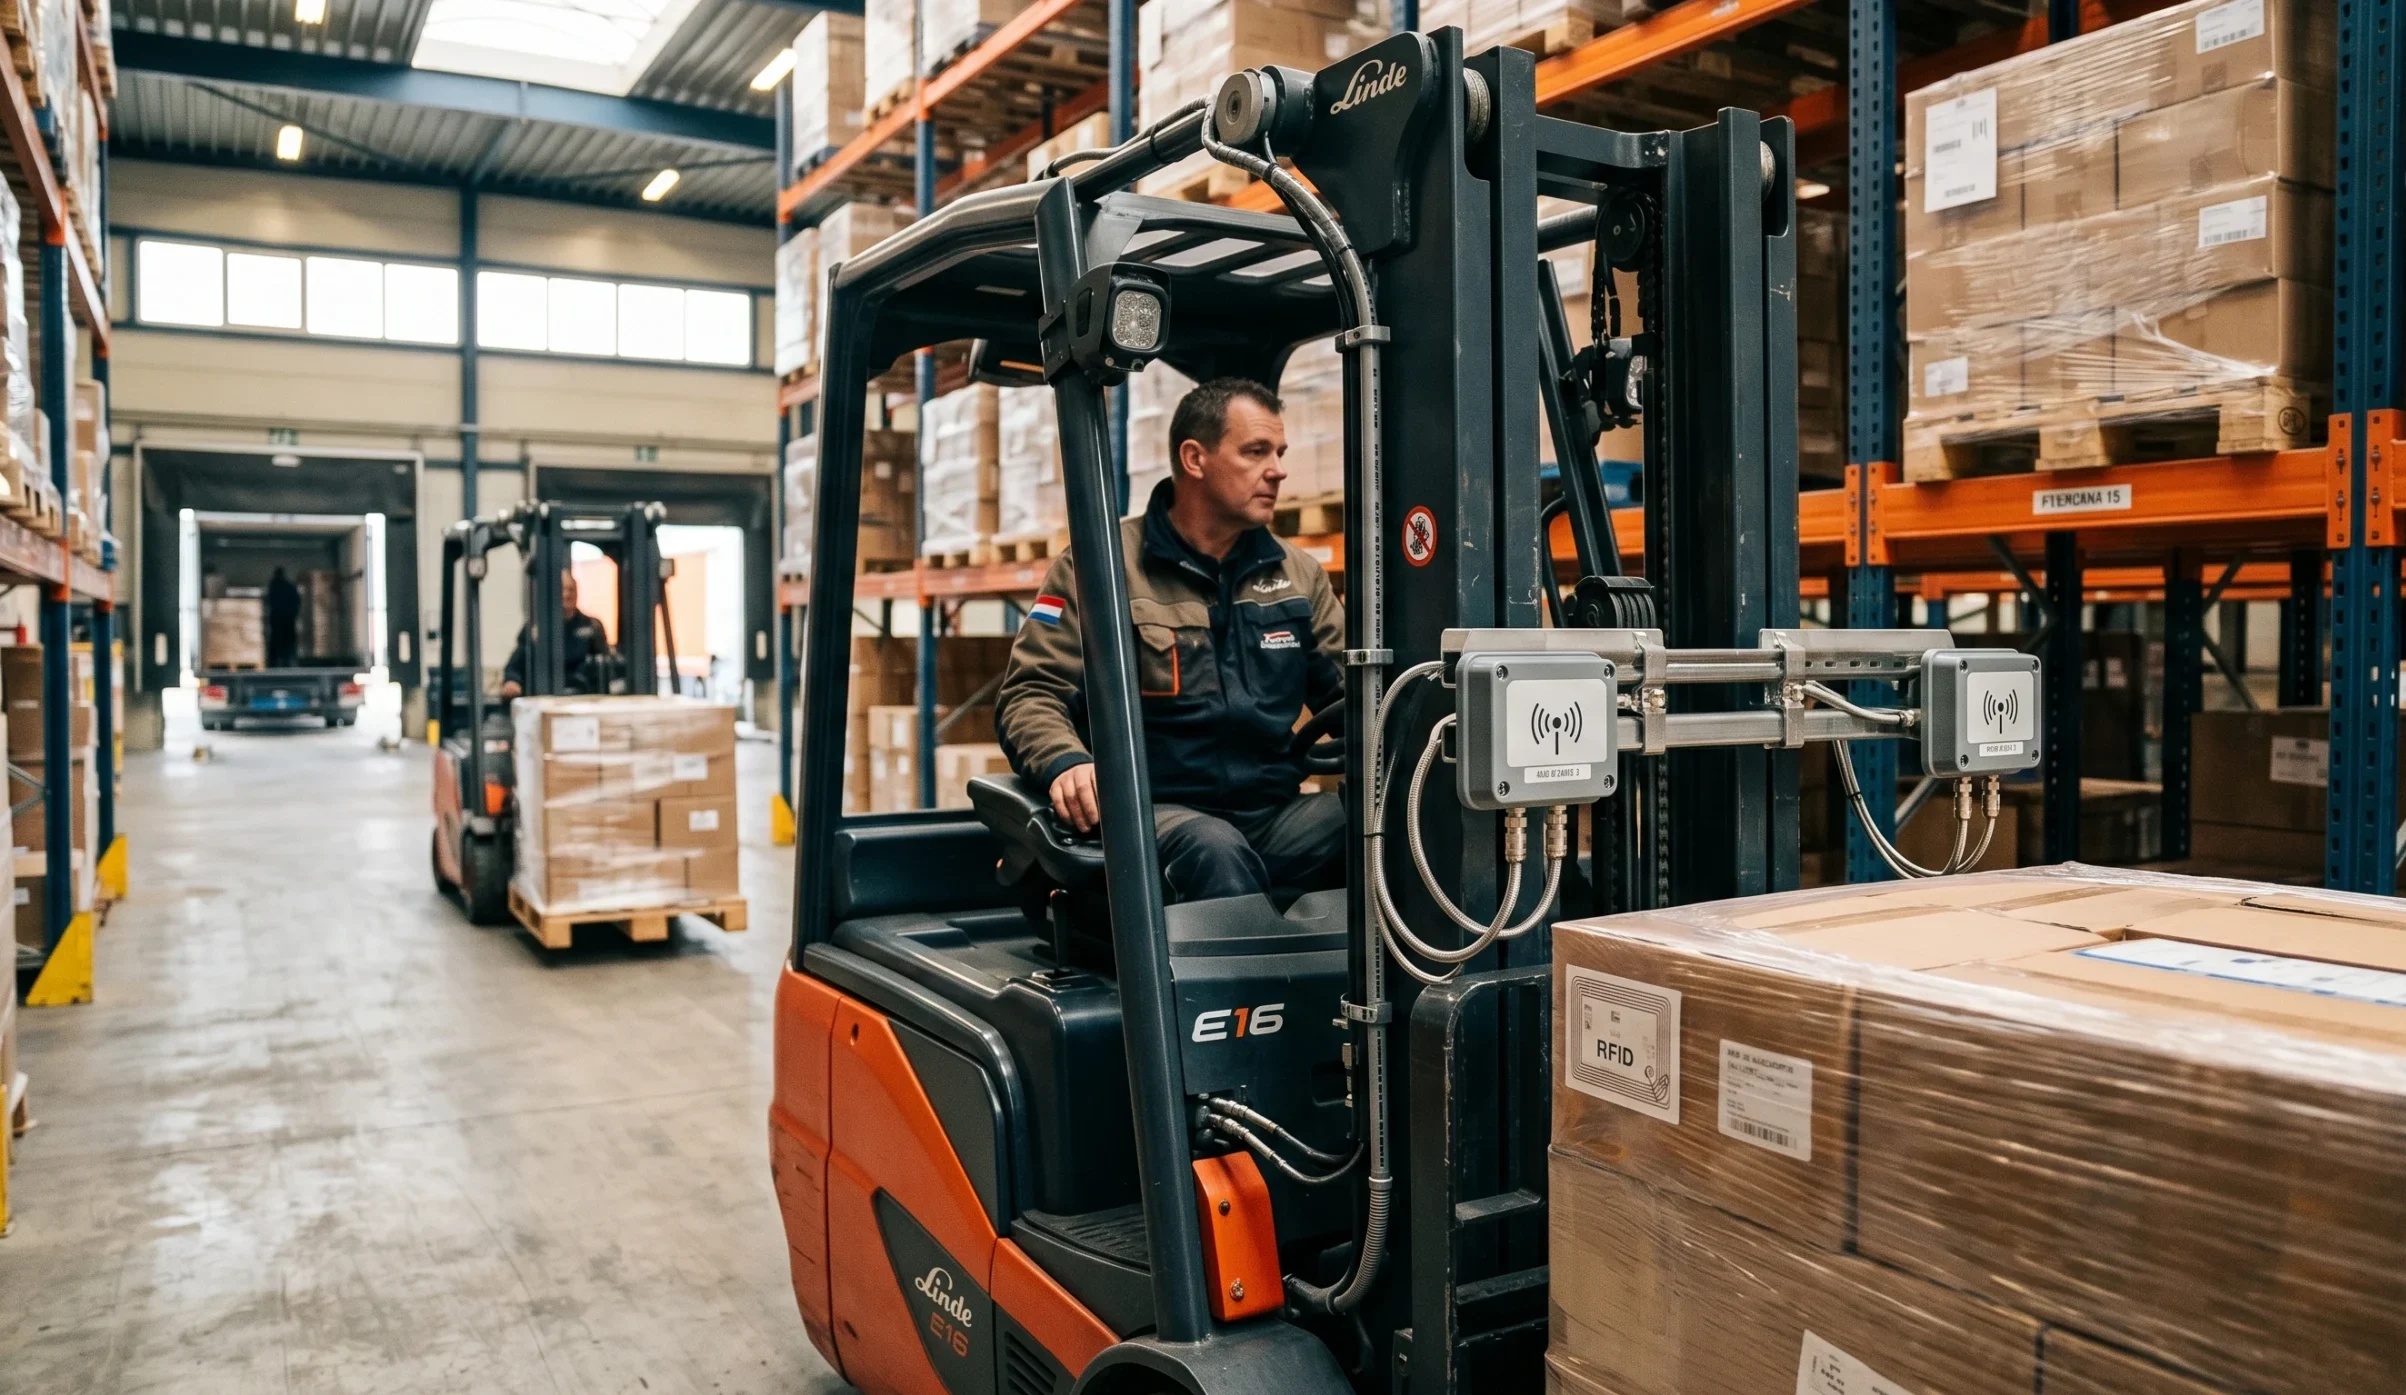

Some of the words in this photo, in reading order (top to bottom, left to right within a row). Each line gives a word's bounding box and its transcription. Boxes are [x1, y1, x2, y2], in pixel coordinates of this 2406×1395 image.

[1330, 59, 1407, 115] Linde
[2107, 490, 2120, 503] 15
[1192, 1003, 1285, 1042] E16
[1597, 1039, 1634, 1067] RFID
[915, 1267, 972, 1328] Linde
[930, 1312, 969, 1357] E16
